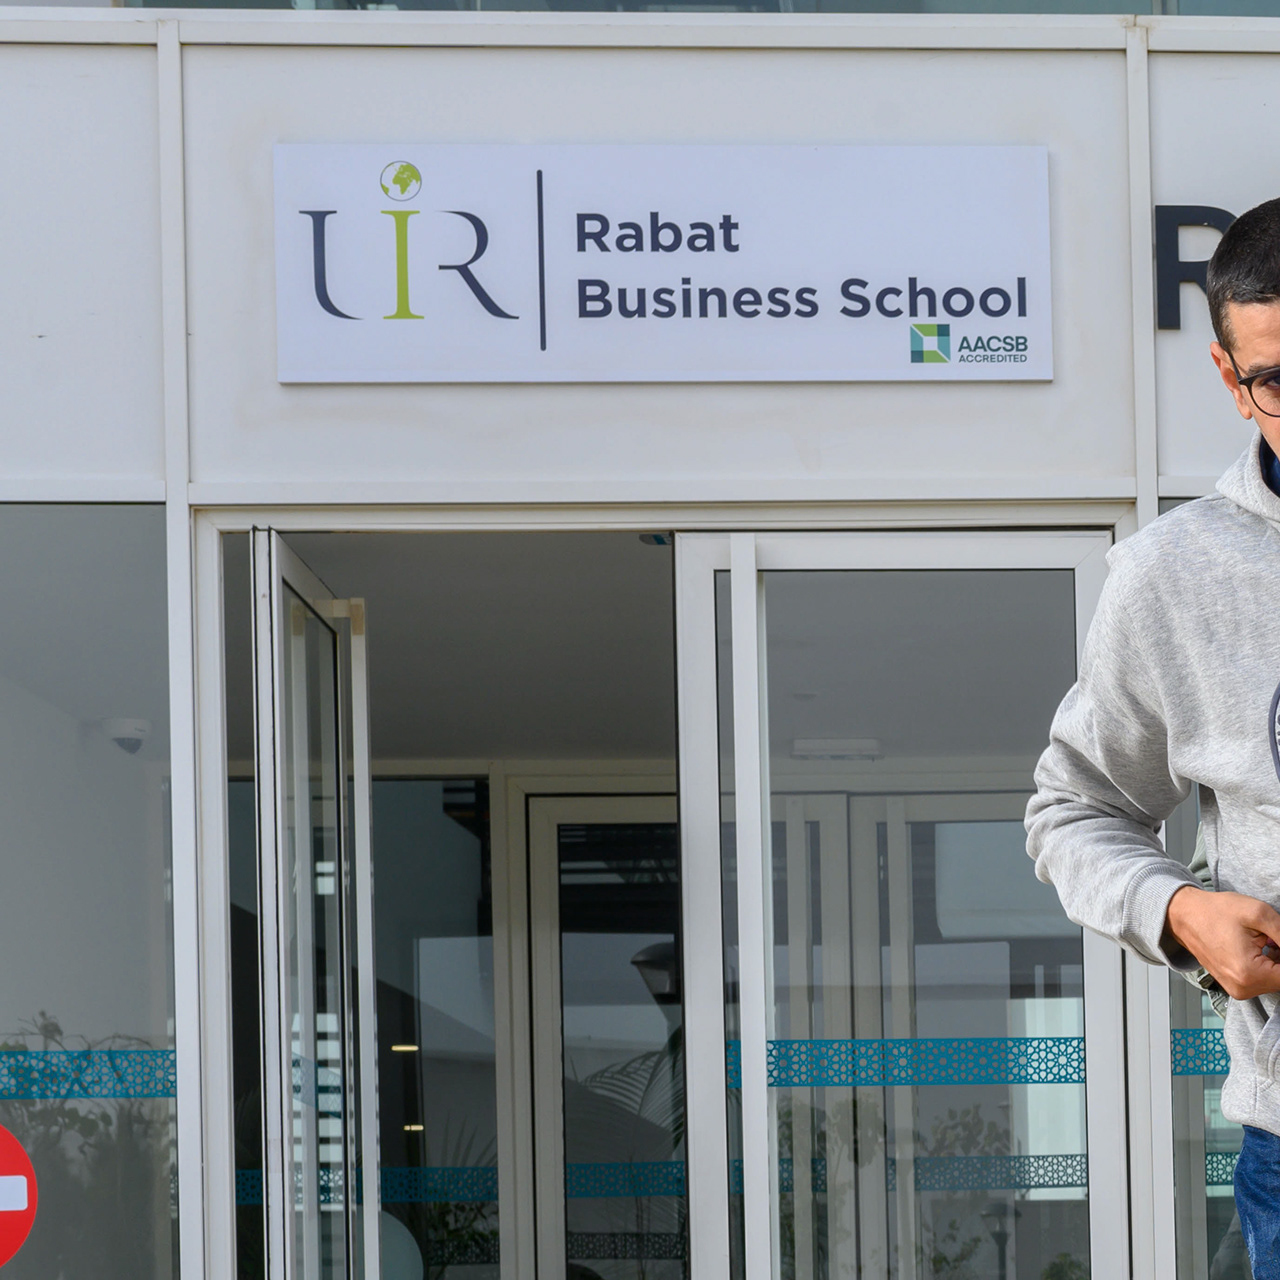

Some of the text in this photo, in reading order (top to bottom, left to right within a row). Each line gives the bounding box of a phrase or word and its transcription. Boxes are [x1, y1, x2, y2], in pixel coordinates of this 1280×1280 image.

[577, 212, 739, 253] Rabat
[298, 210, 519, 320] UIR
[577, 276, 1027, 319] Business School
[958, 335, 1028, 352] AACSB
[958, 354, 1028, 363] ACCREDITED
